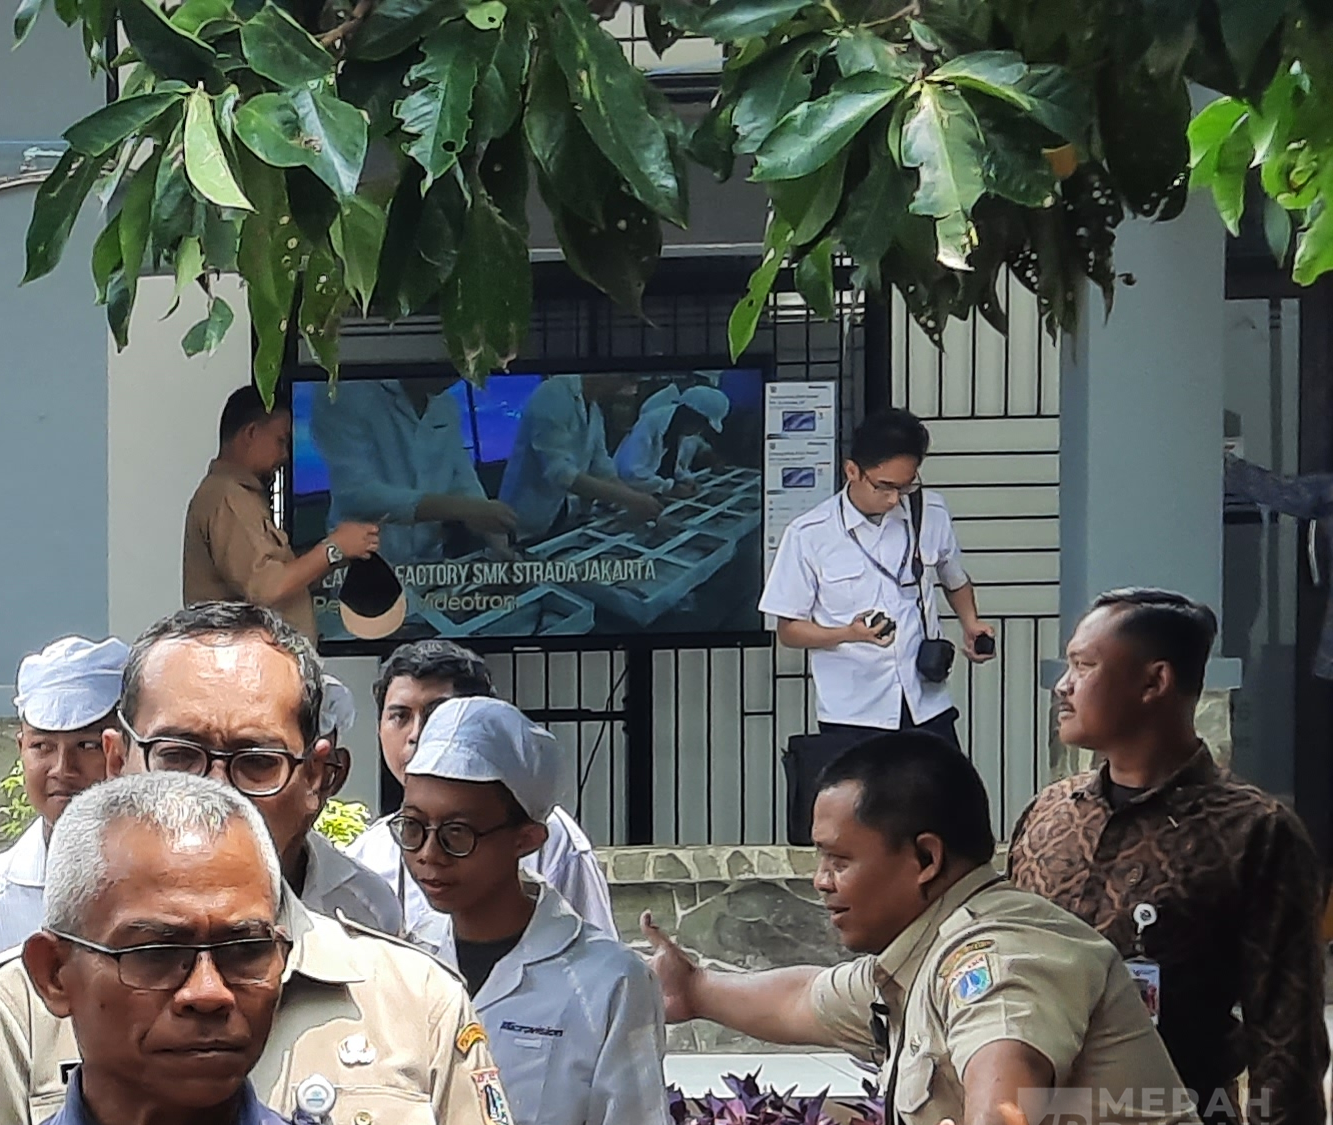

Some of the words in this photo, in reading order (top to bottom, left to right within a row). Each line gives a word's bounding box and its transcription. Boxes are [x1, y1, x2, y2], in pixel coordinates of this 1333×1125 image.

[395, 564, 469, 587] FACTORY
[473, 563, 510, 585] SMK
[513, 561, 579, 584] STRADA
[581, 559, 656, 582] JAKARTA
